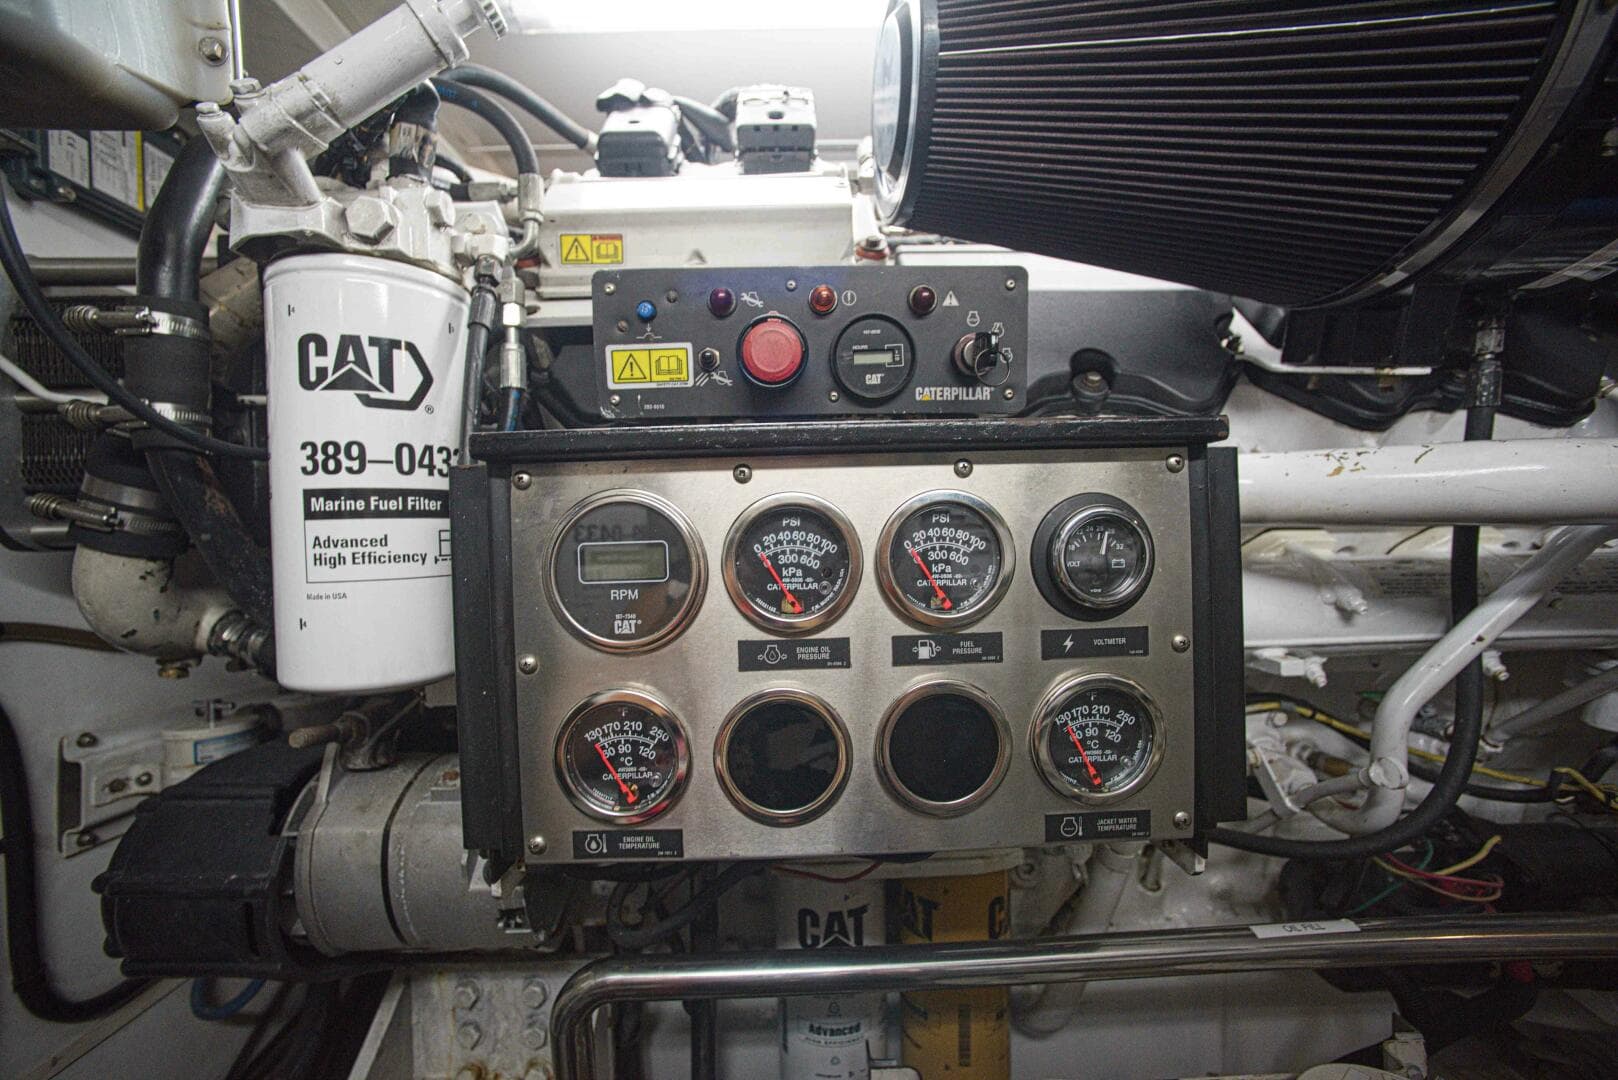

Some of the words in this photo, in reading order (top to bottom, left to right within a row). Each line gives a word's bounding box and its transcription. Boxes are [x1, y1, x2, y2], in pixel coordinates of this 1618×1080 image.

[915, 386, 991, 401] CATERPILLAR
[310, 496, 365, 512] Marine
[370, 496, 403, 511] Fuel
[407, 496, 442, 511] Filter
[782, 517, 802, 528] PSI
[932, 514, 950, 524] PSI
[312, 534, 389, 550] Advanced
[753, 544, 762, 554] 0
[762, 533, 778, 546] 20
[777, 530, 792, 541] 40
[792, 531, 806, 541] 60
[806, 532, 822, 545] 80
[820, 538, 838, 554] 100
[904, 540, 912, 550] 0
[913, 530, 926, 542] 20
[927, 528, 940, 537] 40
[942, 528, 956, 538] 60
[956, 530, 970, 541] 80
[969, 535, 986, 550] 100
[313, 553, 347, 569] High
[351, 551, 428, 566] Efficiency
[778, 554, 798, 565] 300
[800, 554, 820, 570] 600
[928, 550, 948, 560] 300
[948, 551, 969, 566] 600
[932, 563, 952, 573] kPa
[1066, 560, 1081, 568] VOLT
[782, 567, 803, 577] kPa
[916, 578, 967, 587] CATRPILLAR
[324, 592, 331, 600] in
[332, 592, 348, 600] USA
[610, 589, 639, 600] RPM
[960, 640, 975, 648] FUEL
[1093, 638, 1127, 646] VOLTMETER
[796, 646, 819, 654] ENGINE
[797, 652, 830, 660] PRESSURE
[1055, 711, 1072, 726] 130
[1072, 705, 1090, 717] 170
[1092, 704, 1110, 714] 210
[1116, 710, 1136, 726] 250
[584, 727, 602, 742] 130
[602, 722, 620, 734] 170
[624, 722, 642, 731] 210
[649, 726, 670, 742] 250
[1084, 727, 1098, 738] 90
[1104, 728, 1122, 744] 120
[618, 744, 632, 754] 90
[638, 746, 656, 760] 120
[1068, 754, 1118, 764] CATRPILLAR
[602, 771, 653, 780] CAERPILLAR
[1096, 818, 1118, 826] JACKET
[1096, 824, 1137, 832] TEMPERATURE
[618, 842, 661, 850] TEMPERATURE
